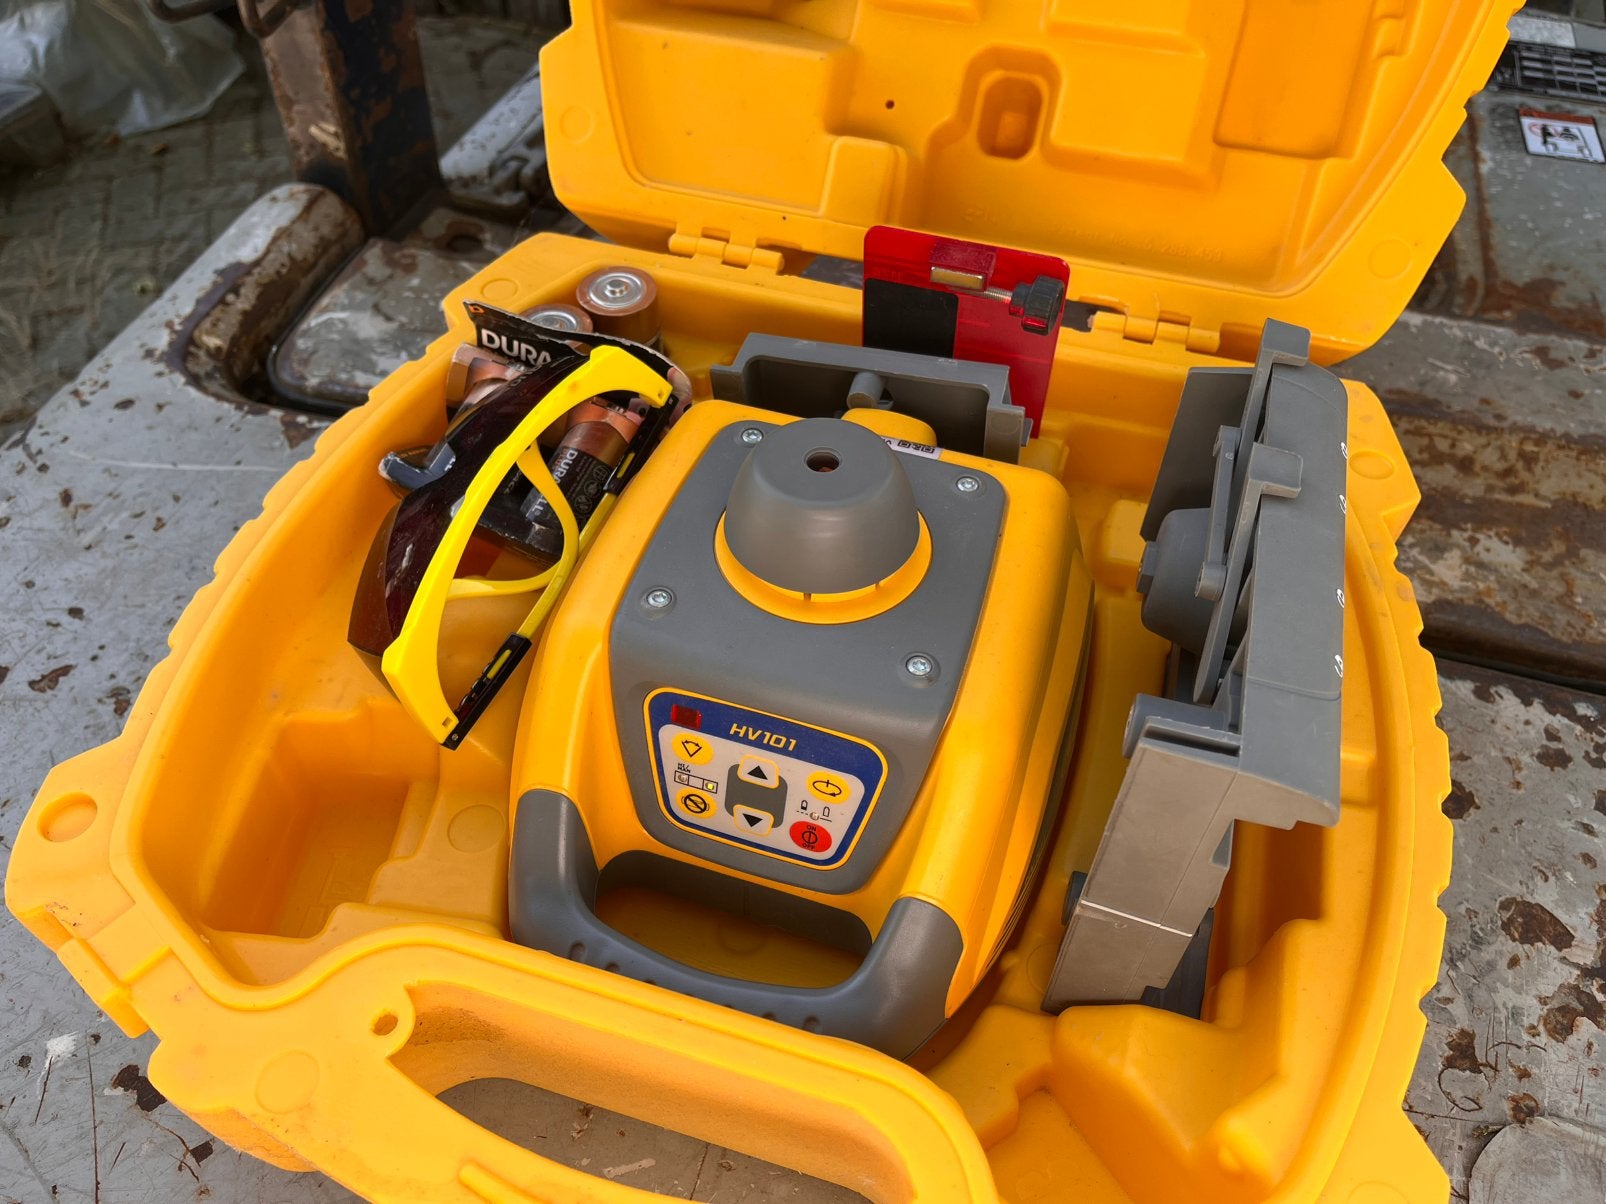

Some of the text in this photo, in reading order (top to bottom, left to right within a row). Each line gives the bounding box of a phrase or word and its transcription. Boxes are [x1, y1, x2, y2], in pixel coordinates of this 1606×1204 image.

[481, 328, 552, 367] DURA
[729, 723, 797, 751] HV101
[806, 824, 817, 832] ON
[802, 842, 816, 850] OFF
